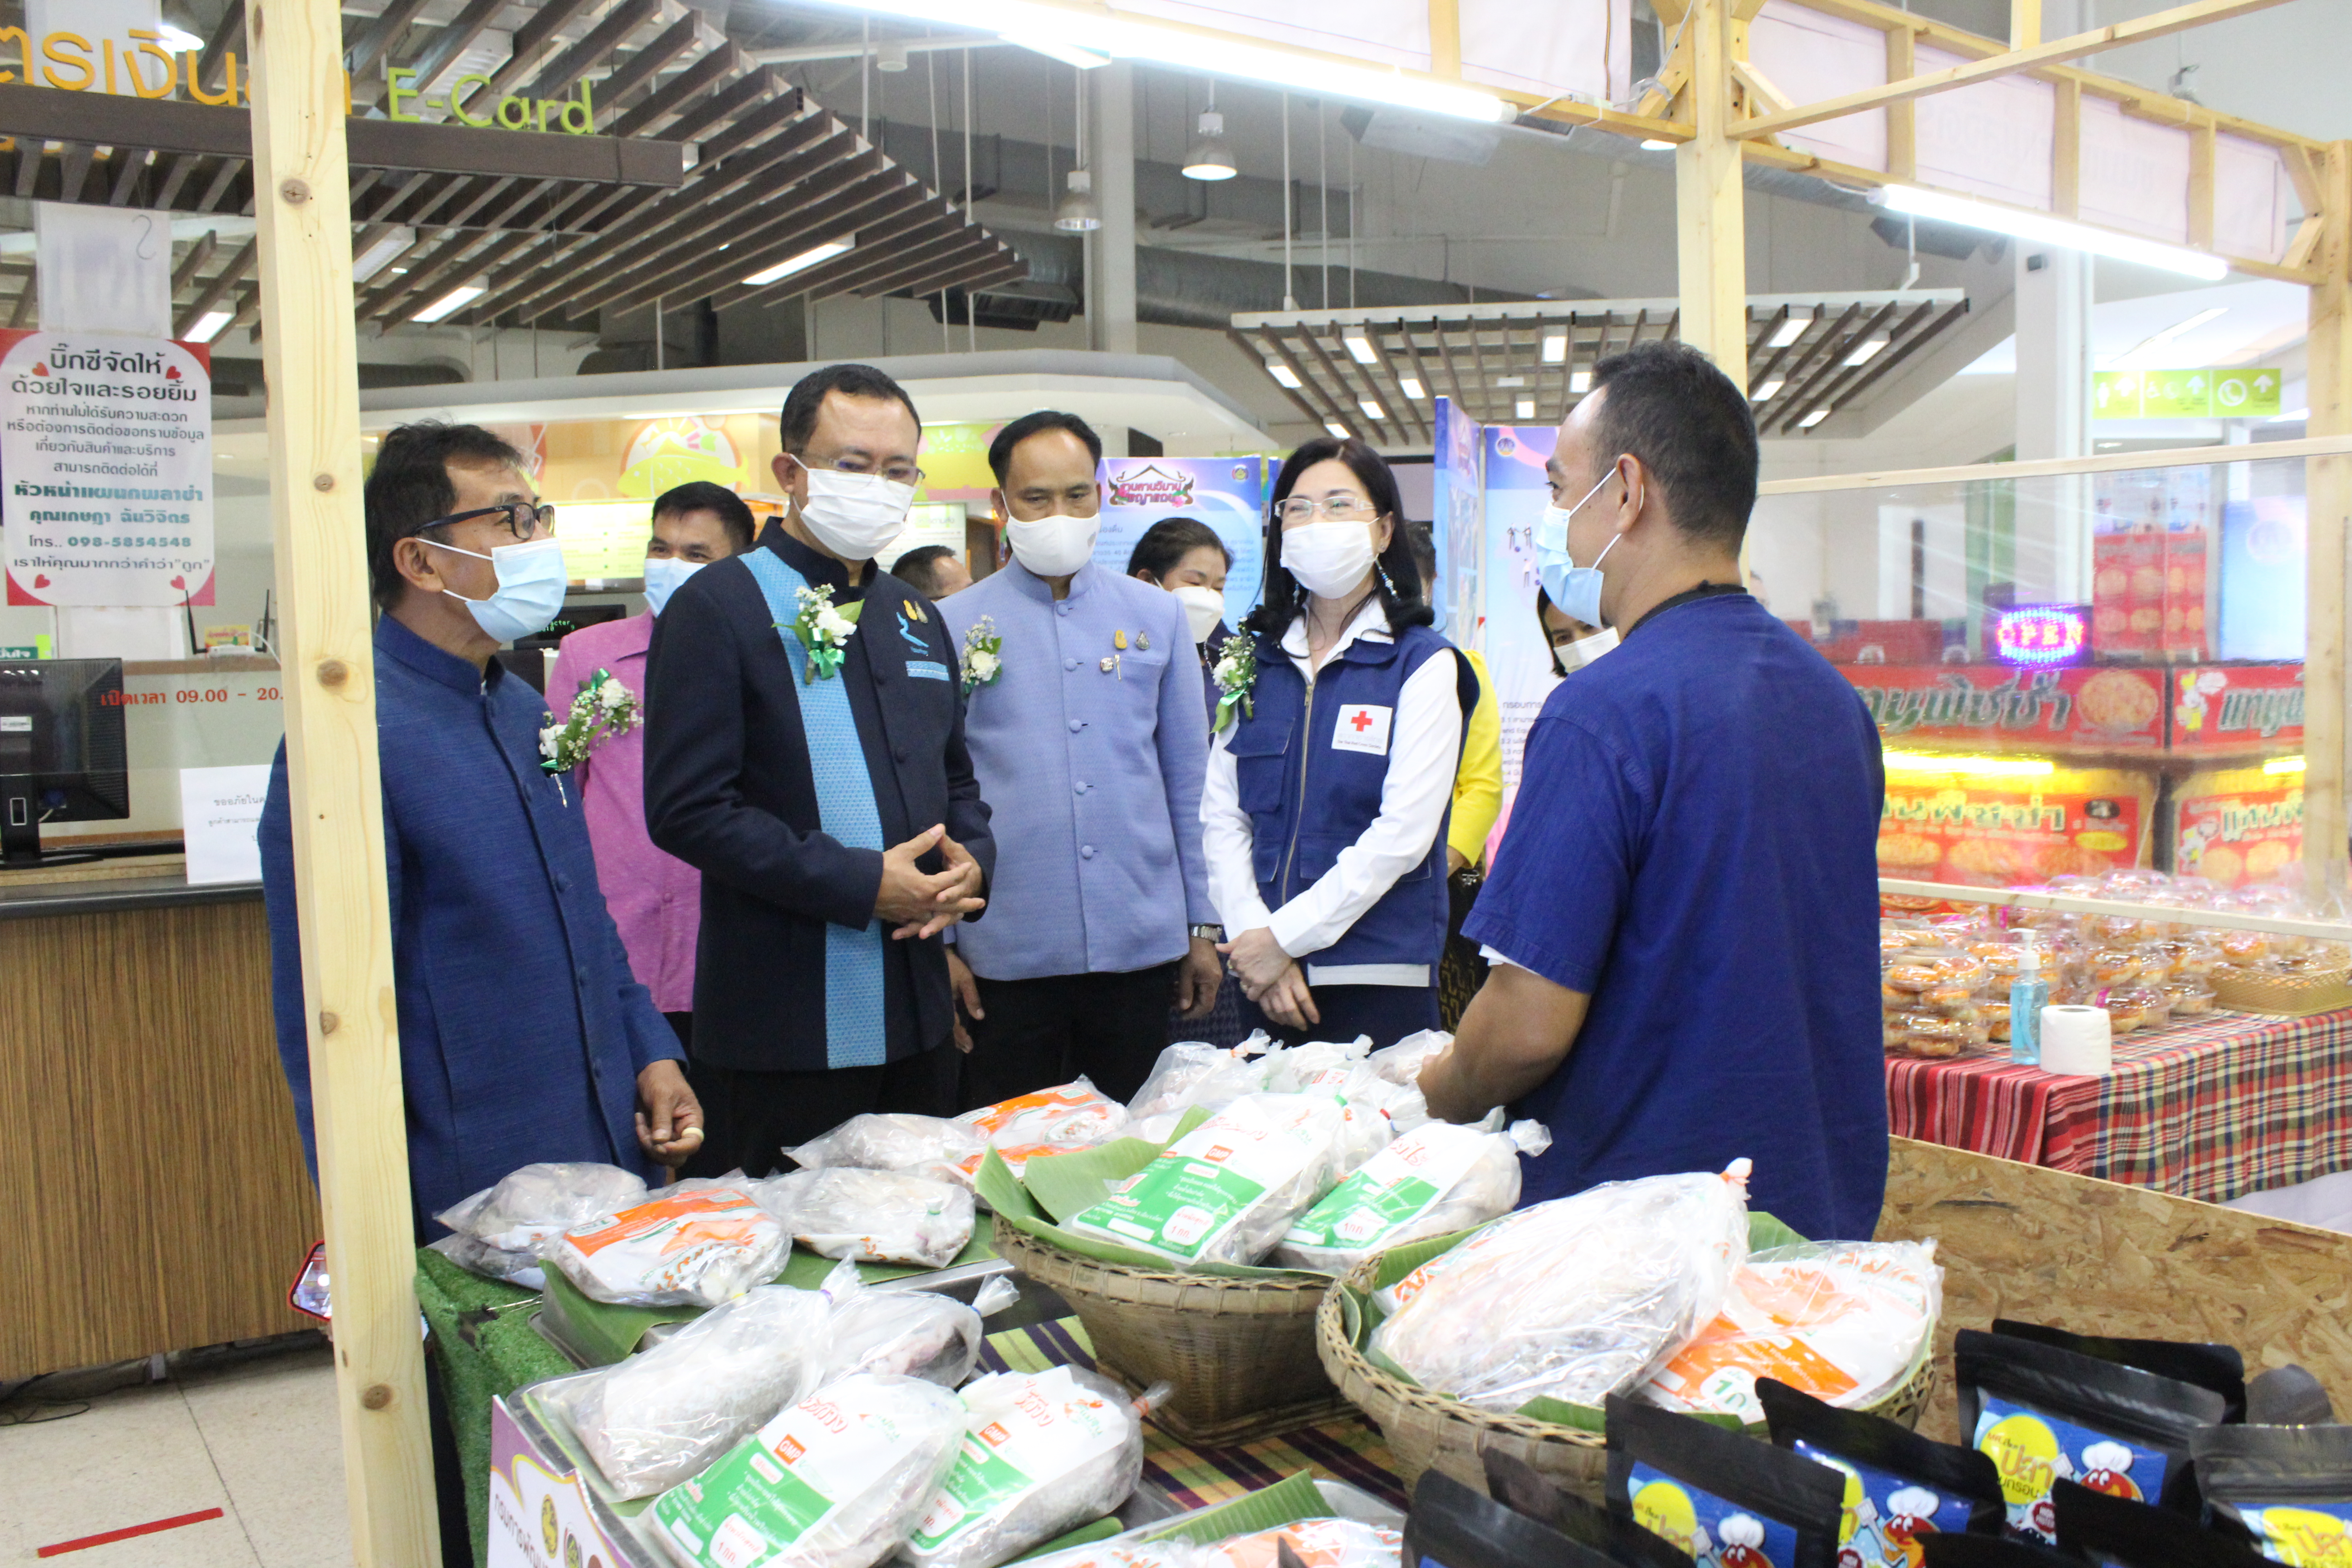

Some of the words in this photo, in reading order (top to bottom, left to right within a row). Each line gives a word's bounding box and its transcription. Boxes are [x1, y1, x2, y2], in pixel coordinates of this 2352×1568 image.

[388, 67, 594, 135] E-Card
[50, 343, 165, 374] บิ๊กซีจัดให้
[11, 374, 196, 402] ด้วยใจและรอยยิ้ม
[26, 401, 188, 422] หากท่านไม่ได้รับความสะดวก
[7, 418, 204, 443] หรือต้องการติดต่อขอทราบข้อมูล
[36, 435, 176, 457] เกี่ยวกับสินค้าและบริการ
[54, 461, 158, 477] สามารถติดต่อได้ที่
[14, 480, 203, 501] หัวหน้าแผนกพลาซ่า
[1997, 623, 2084, 647] OPEN
[101, 689, 167, 706] เปิดเวลา
[176, 689, 227, 703] 09.00
[257, 687, 284, 701] 20.
[214, 794, 266, 806] ขออภัยในค
[1207, 1148, 1229, 1160] GMP
[984, 1425, 1007, 1443] GMP
[778, 1439, 803, 1460] GMP
[2001, 1444, 2053, 1489] ปลา
[1998, 1475, 2040, 1498] บกรอบ
